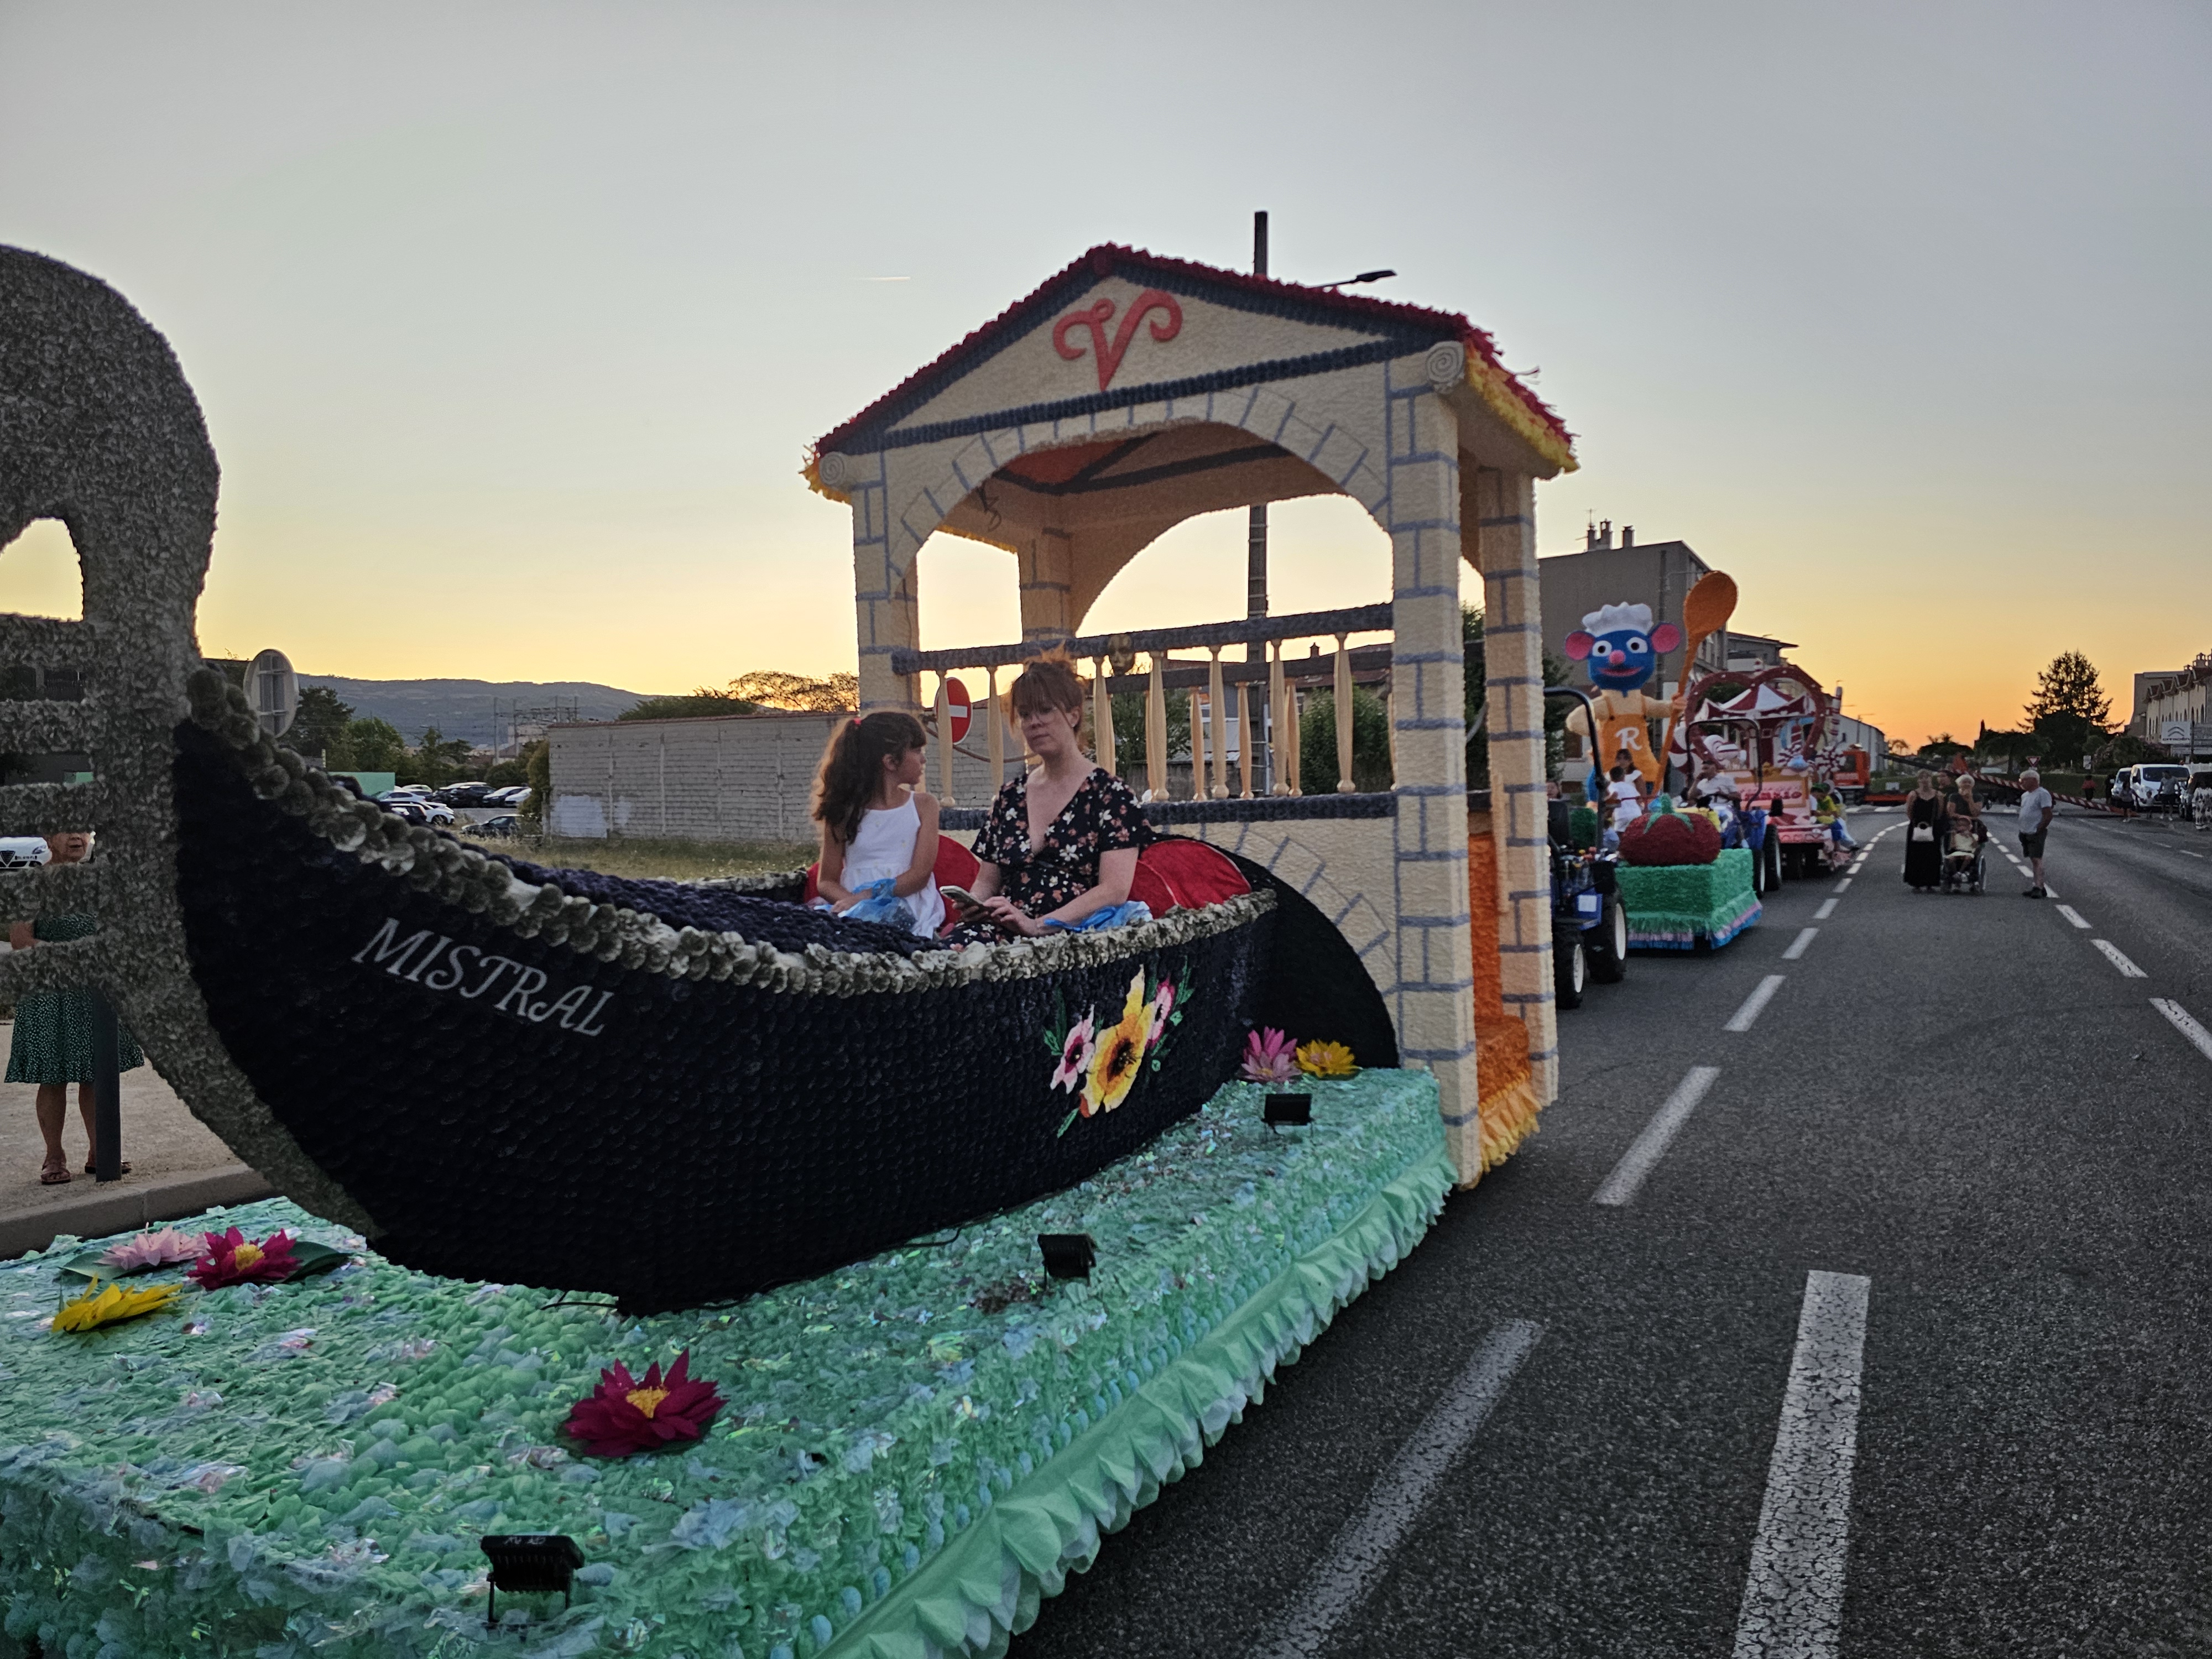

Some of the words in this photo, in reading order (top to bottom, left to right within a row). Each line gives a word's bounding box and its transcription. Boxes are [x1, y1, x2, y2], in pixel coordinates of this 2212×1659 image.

[1053, 288, 1182, 393] V
[1615, 727, 1642, 750] R
[352, 917, 614, 1036] MISTRAL
